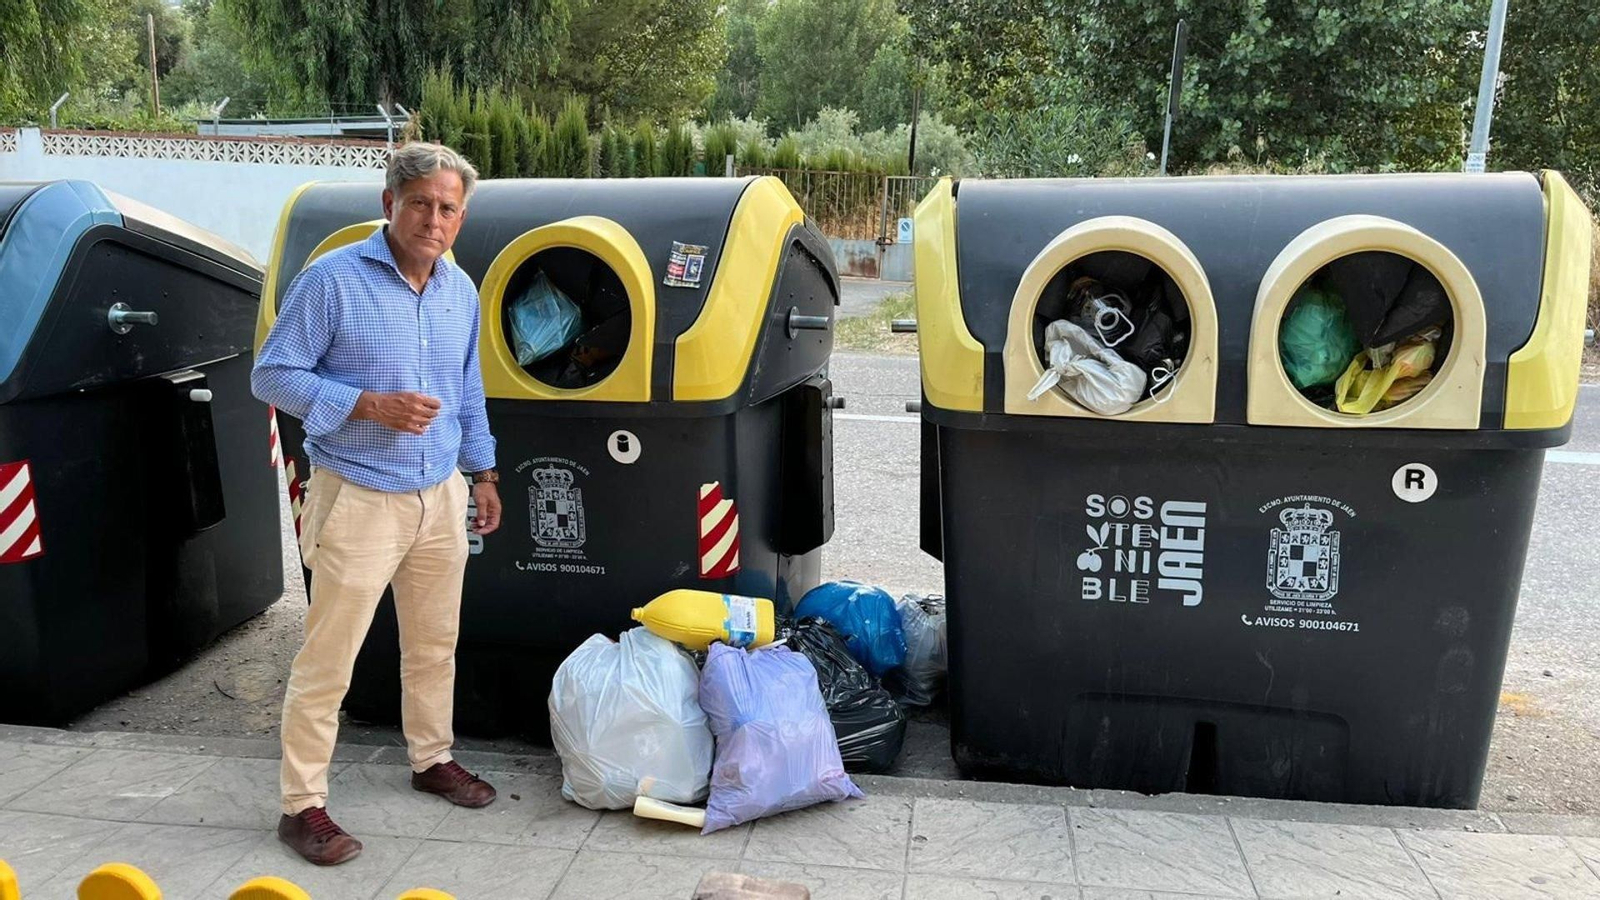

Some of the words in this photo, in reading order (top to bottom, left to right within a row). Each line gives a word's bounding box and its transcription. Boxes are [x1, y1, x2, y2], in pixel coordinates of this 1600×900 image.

[1405, 468, 1426, 490] R
[1085, 493, 1154, 520] SOS
[1283, 494, 1331, 505] AYUNTAMIENTO
[1331, 499, 1342, 508] DE
[526, 562, 558, 572] AVISOS
[560, 564, 606, 575] 900104671
[1114, 549, 1151, 574] NI
[1082, 576, 1150, 604] BLE
[1269, 599, 1296, 607] SERVICIO
[1305, 601, 1333, 609] LIMPIEZA
[1254, 616, 1295, 628] AVISOS
[1299, 619, 1360, 633] 900104671
